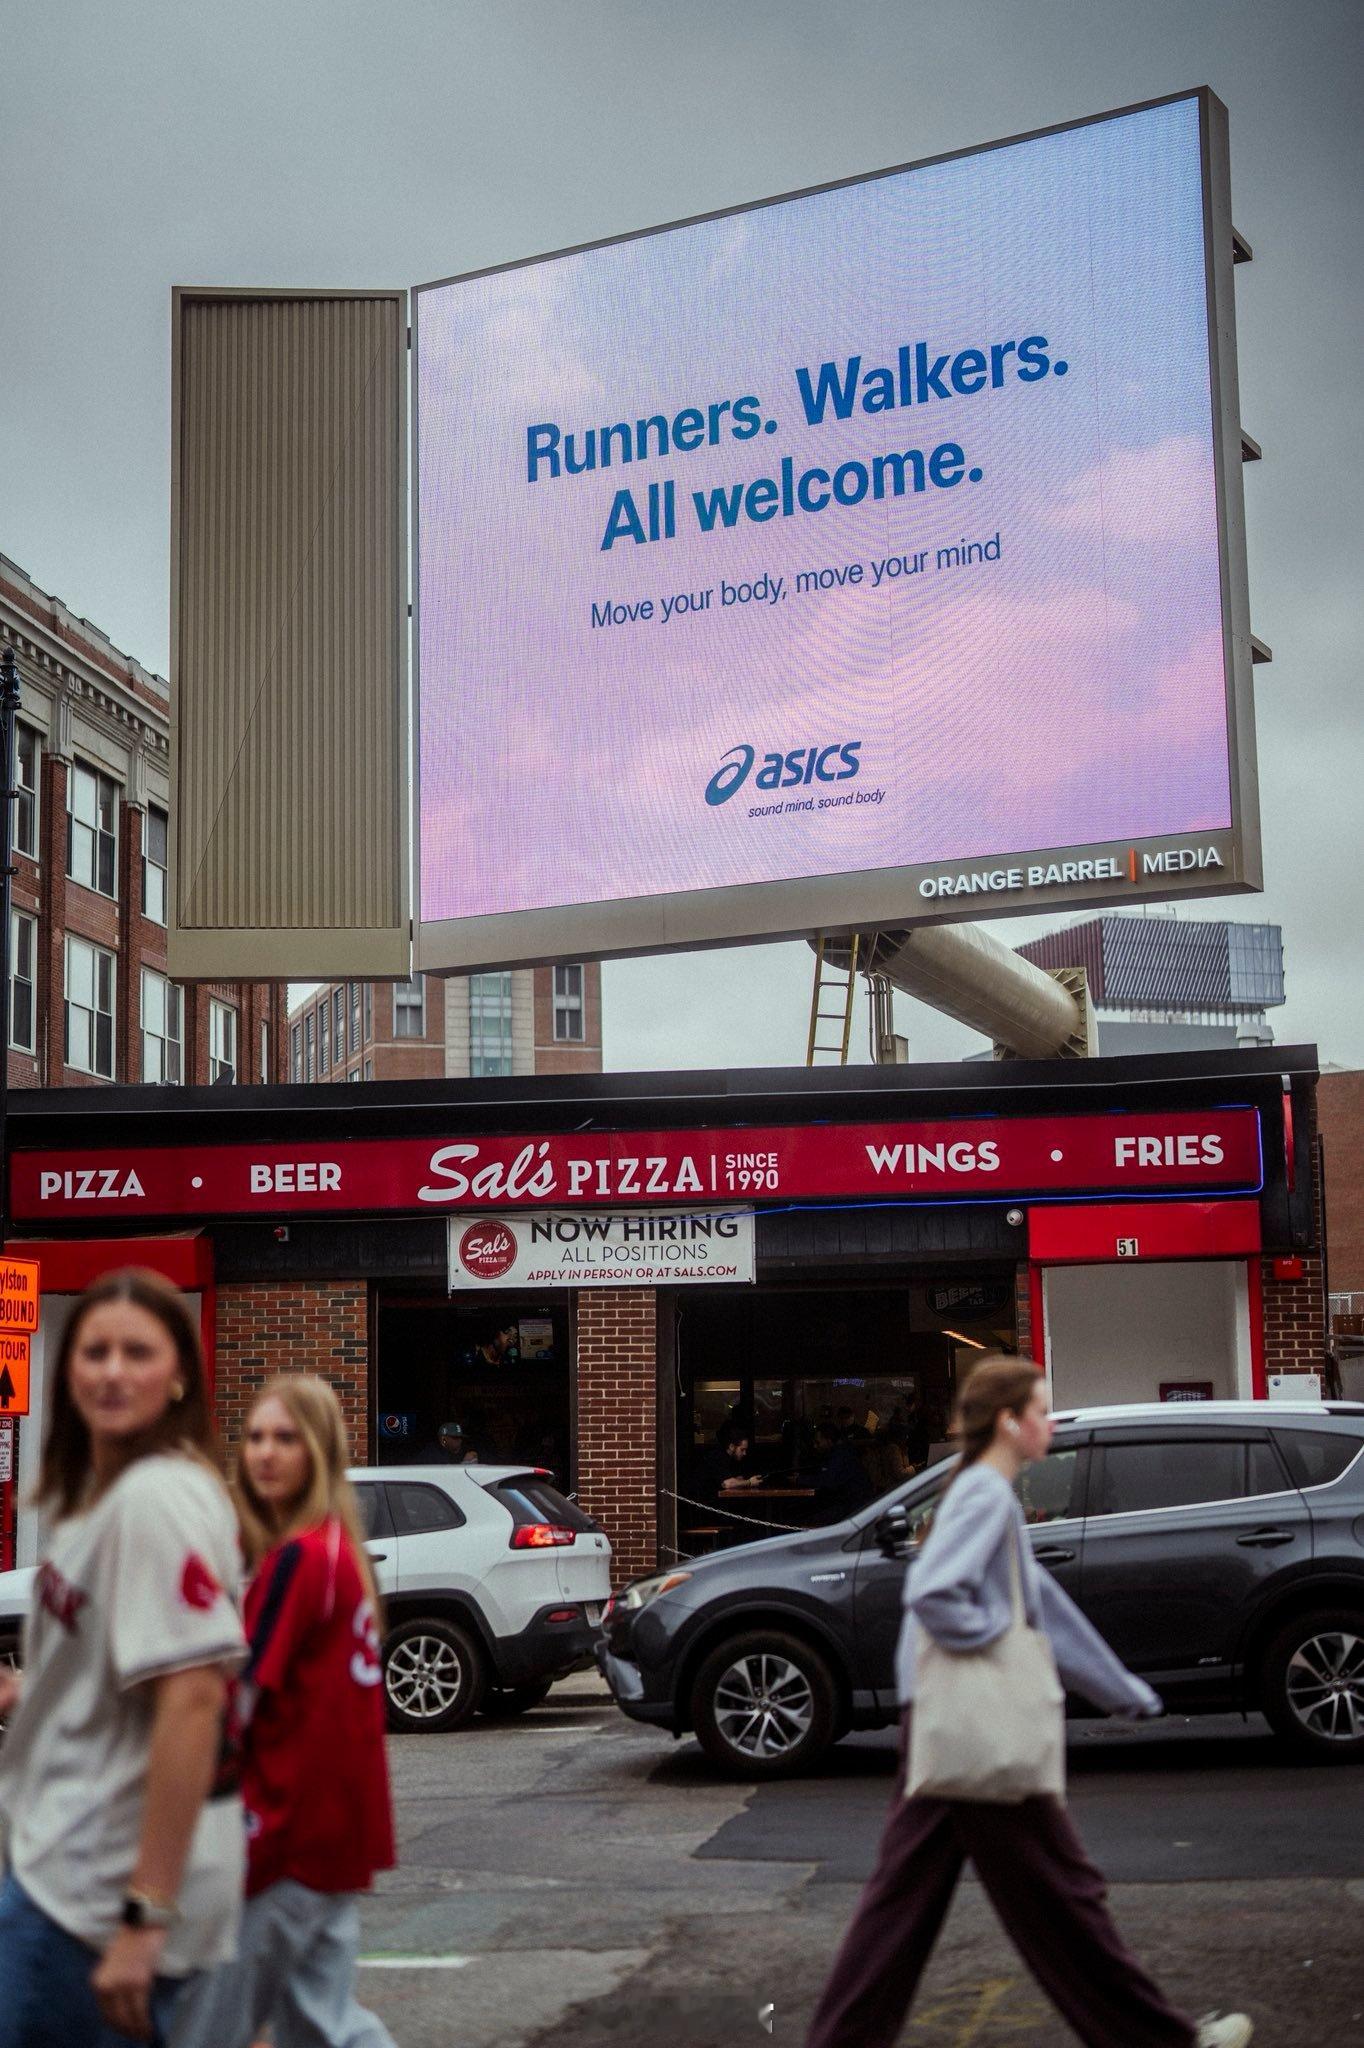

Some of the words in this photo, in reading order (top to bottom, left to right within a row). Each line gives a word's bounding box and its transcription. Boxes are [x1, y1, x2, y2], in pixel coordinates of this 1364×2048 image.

[527, 394, 778, 482] Runners.
[795, 335, 1069, 426] Walkers.
[600, 479, 676, 551] All
[692, 442, 983, 531] welcome.
[592, 600, 654, 629] Move
[661, 588, 714, 623] your
[722, 573, 787, 604] body,
[796, 563, 864, 593] move
[871, 551, 928, 588] your
[937, 532, 1001, 570] mind
[748, 801, 784, 818] sound
[784, 797, 815, 813] mind,
[818, 793, 854, 809] sound
[856, 788, 886, 805] body
[918, 869, 1021, 898] ORANGE
[1028, 857, 1123, 887] BARREL
[1143, 846, 1224, 875] MEDIA
[725, 1152, 778, 1169] SINCE
[865, 1141, 1000, 1174] WINGS
[1114, 1134, 1224, 1167] FRIES
[40, 1169, 146, 1200] PIZZA
[250, 1162, 342, 1193] BEER
[417, 1141, 558, 1202] Sal's
[567, 1155, 704, 1196] PIZZA
[725, 1169, 779, 1191] 1990
[531, 1216, 613, 1243] NOW
[623, 1212, 738, 1242] HIRING
[465, 1231, 511, 1260] Sal's
[478, 1256, 498, 1264] PIZZA
[561, 1247, 596, 1263] ALL
[602, 1243, 708, 1262] POSITIONS
[1118, 1239, 1136, 1256] 51
[527, 1269, 566, 1281] APPLY
[568, 1269, 581, 1280] IN
[583, 1268, 633, 1279] PERSON
[636, 1267, 652, 1278] OR
[656, 1267, 672, 1278] AT
[673, 1265, 737, 1277] SALS.COM
